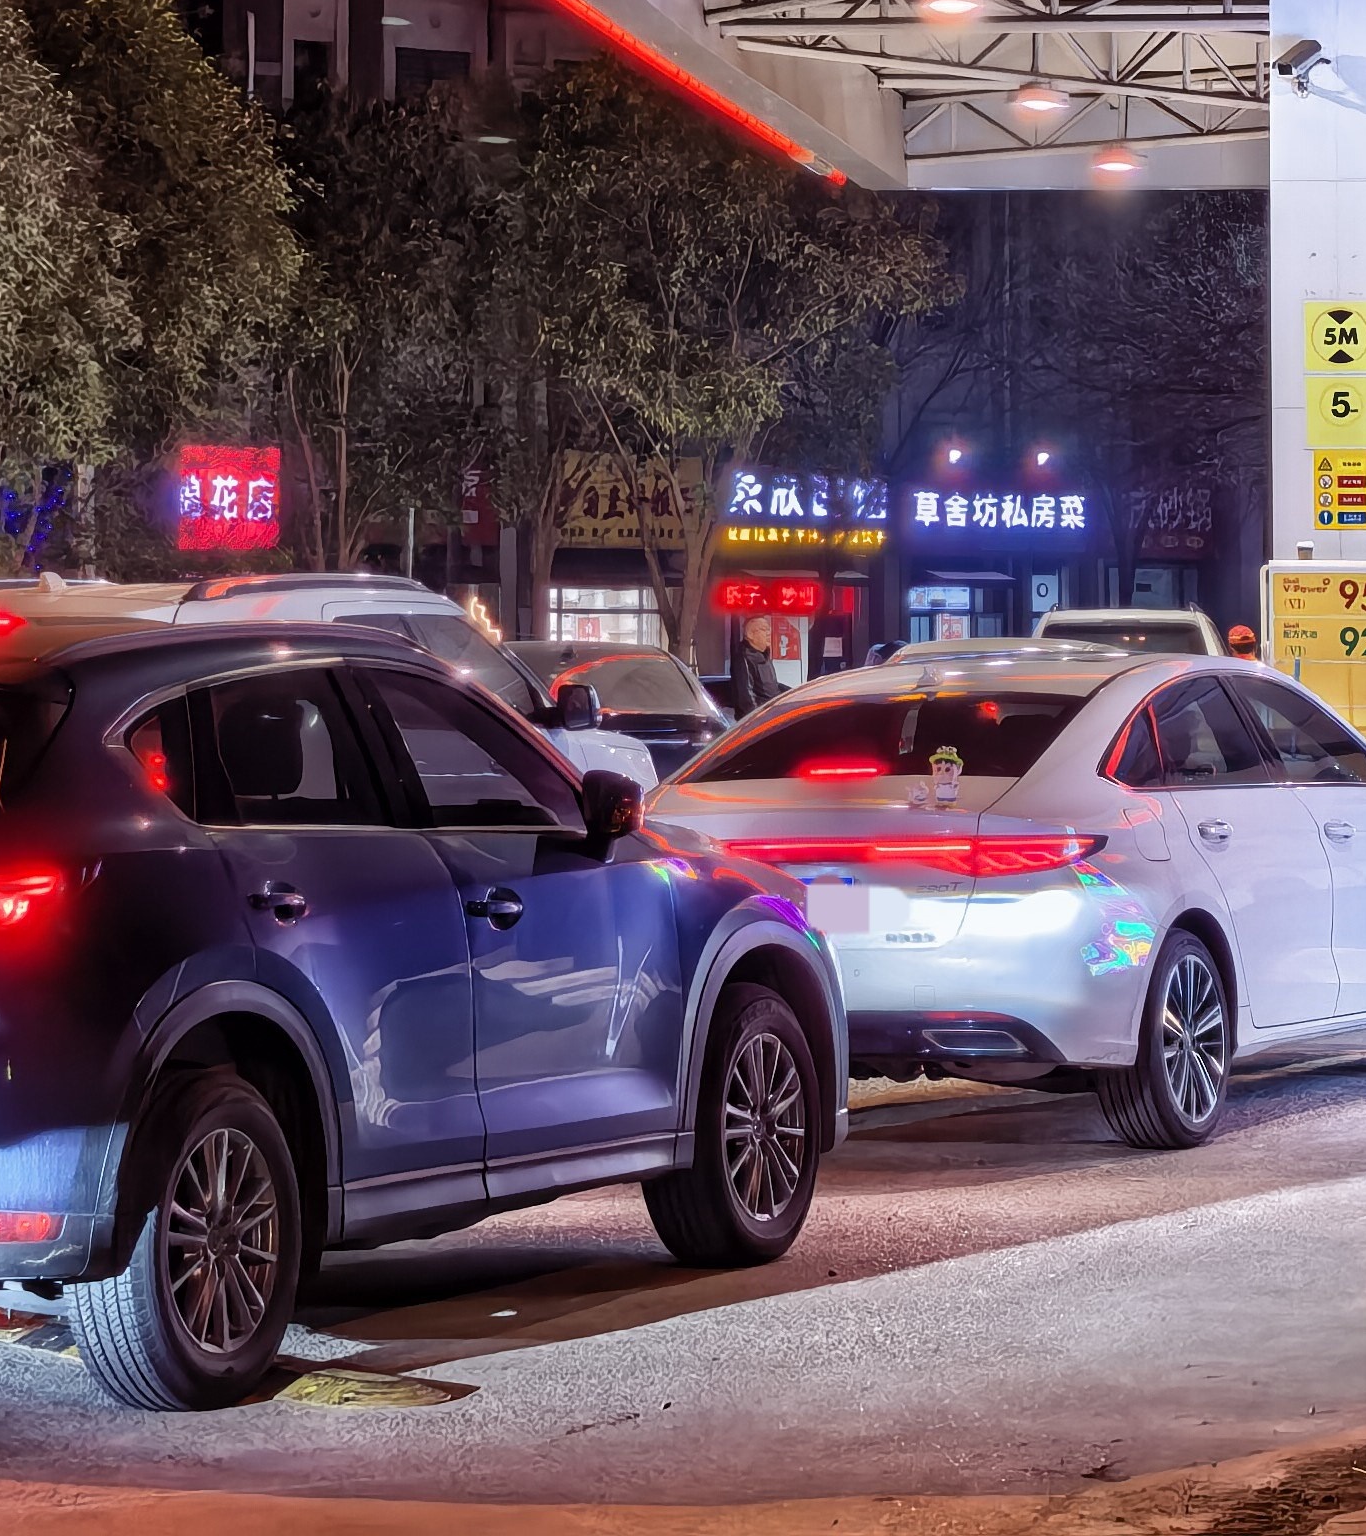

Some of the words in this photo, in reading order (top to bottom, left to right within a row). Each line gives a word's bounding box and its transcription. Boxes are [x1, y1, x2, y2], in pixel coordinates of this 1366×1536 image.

[1324, 327, 1359, 346] 5M
[913, 491, 1086, 529] 草舍坊私房菜
